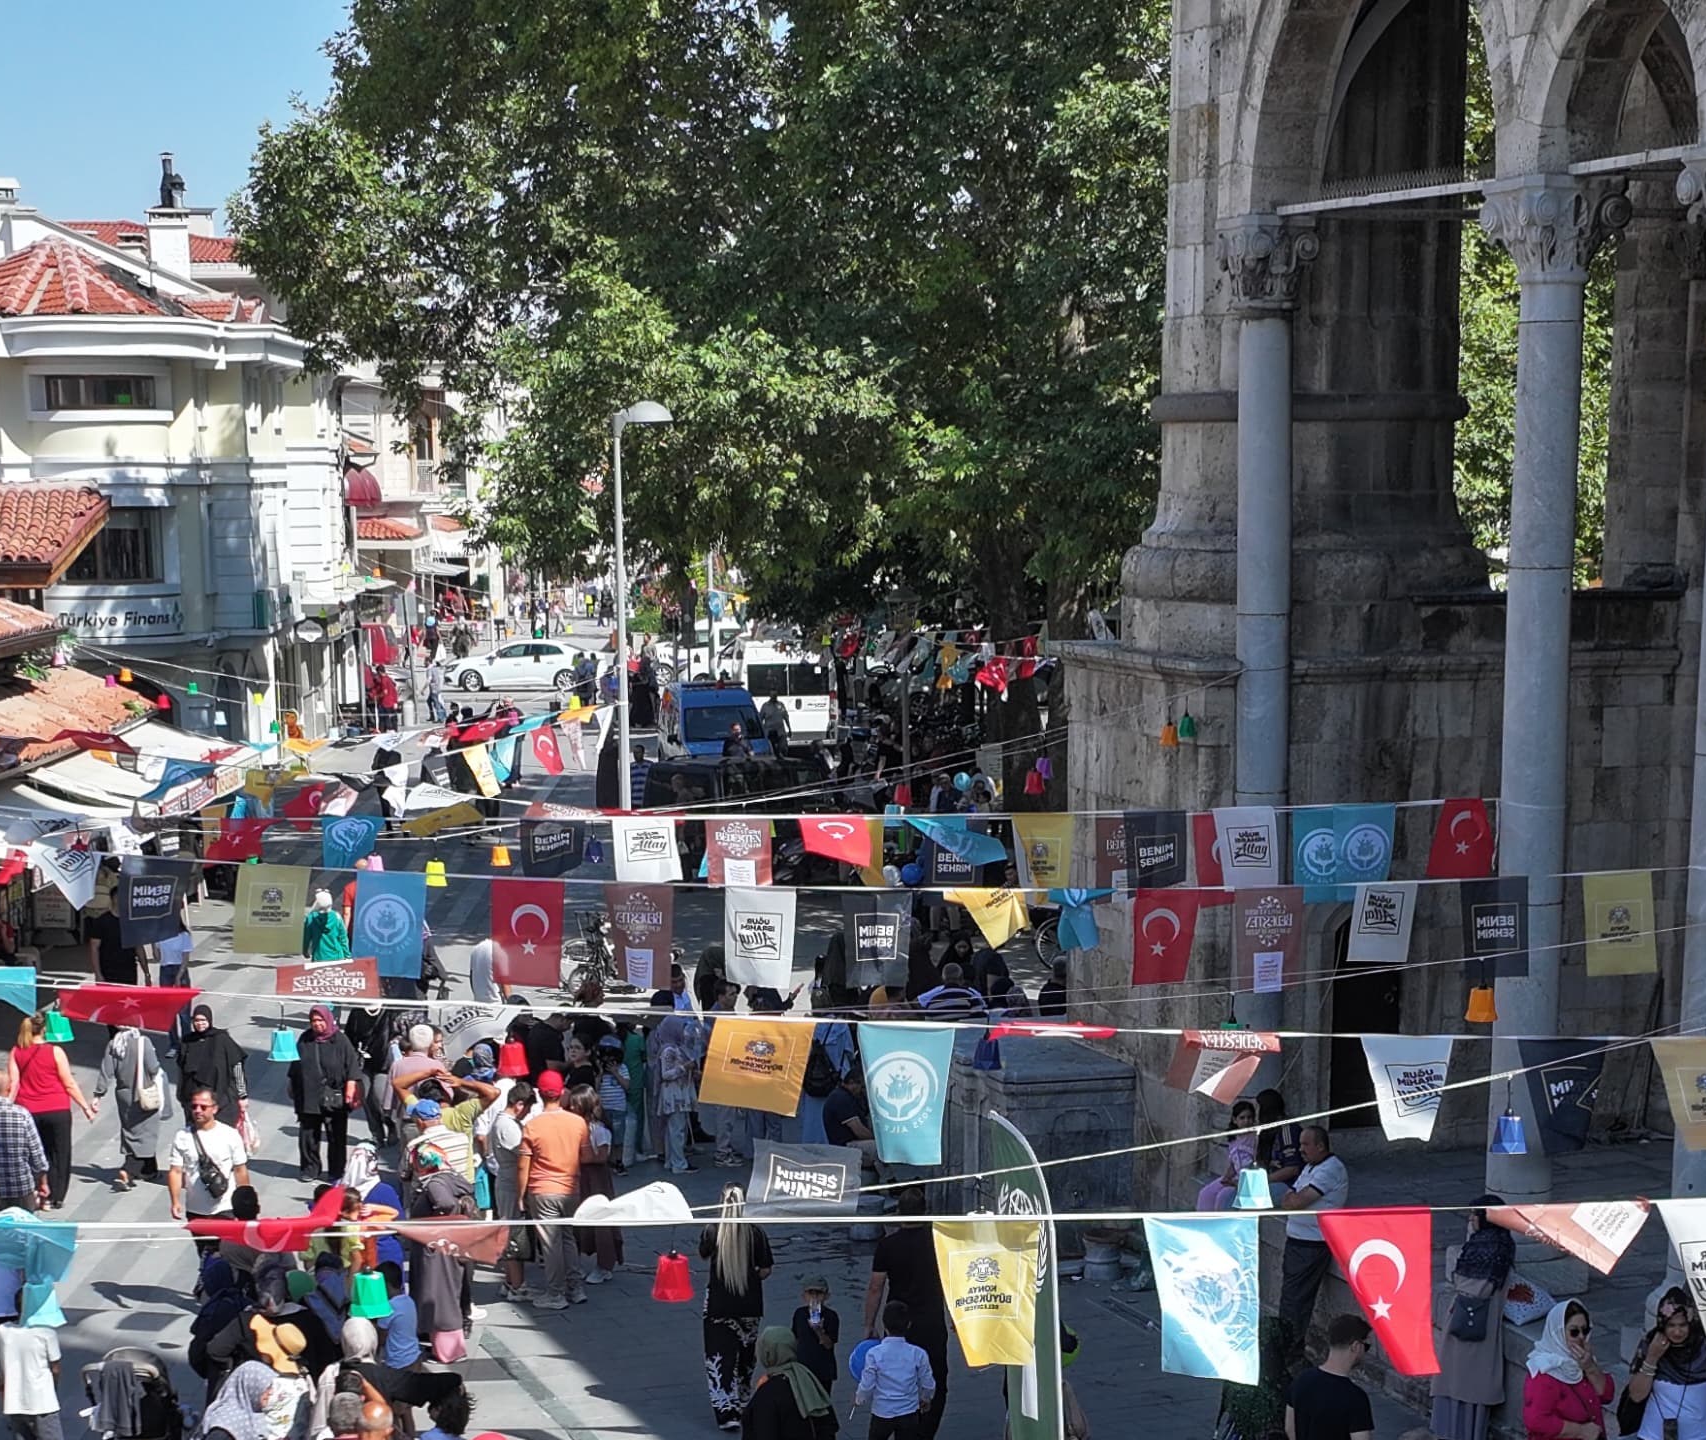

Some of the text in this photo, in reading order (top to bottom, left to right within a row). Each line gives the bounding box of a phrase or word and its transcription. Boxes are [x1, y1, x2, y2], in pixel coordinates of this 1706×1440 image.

[59, 611, 170, 630] Türkiye Finans
[631, 839, 666, 854] Altay
[1139, 843, 1174, 857] BENİM
[1234, 842, 1268, 860] Altay
[777, 1165, 839, 1190] ŞEHRİM
